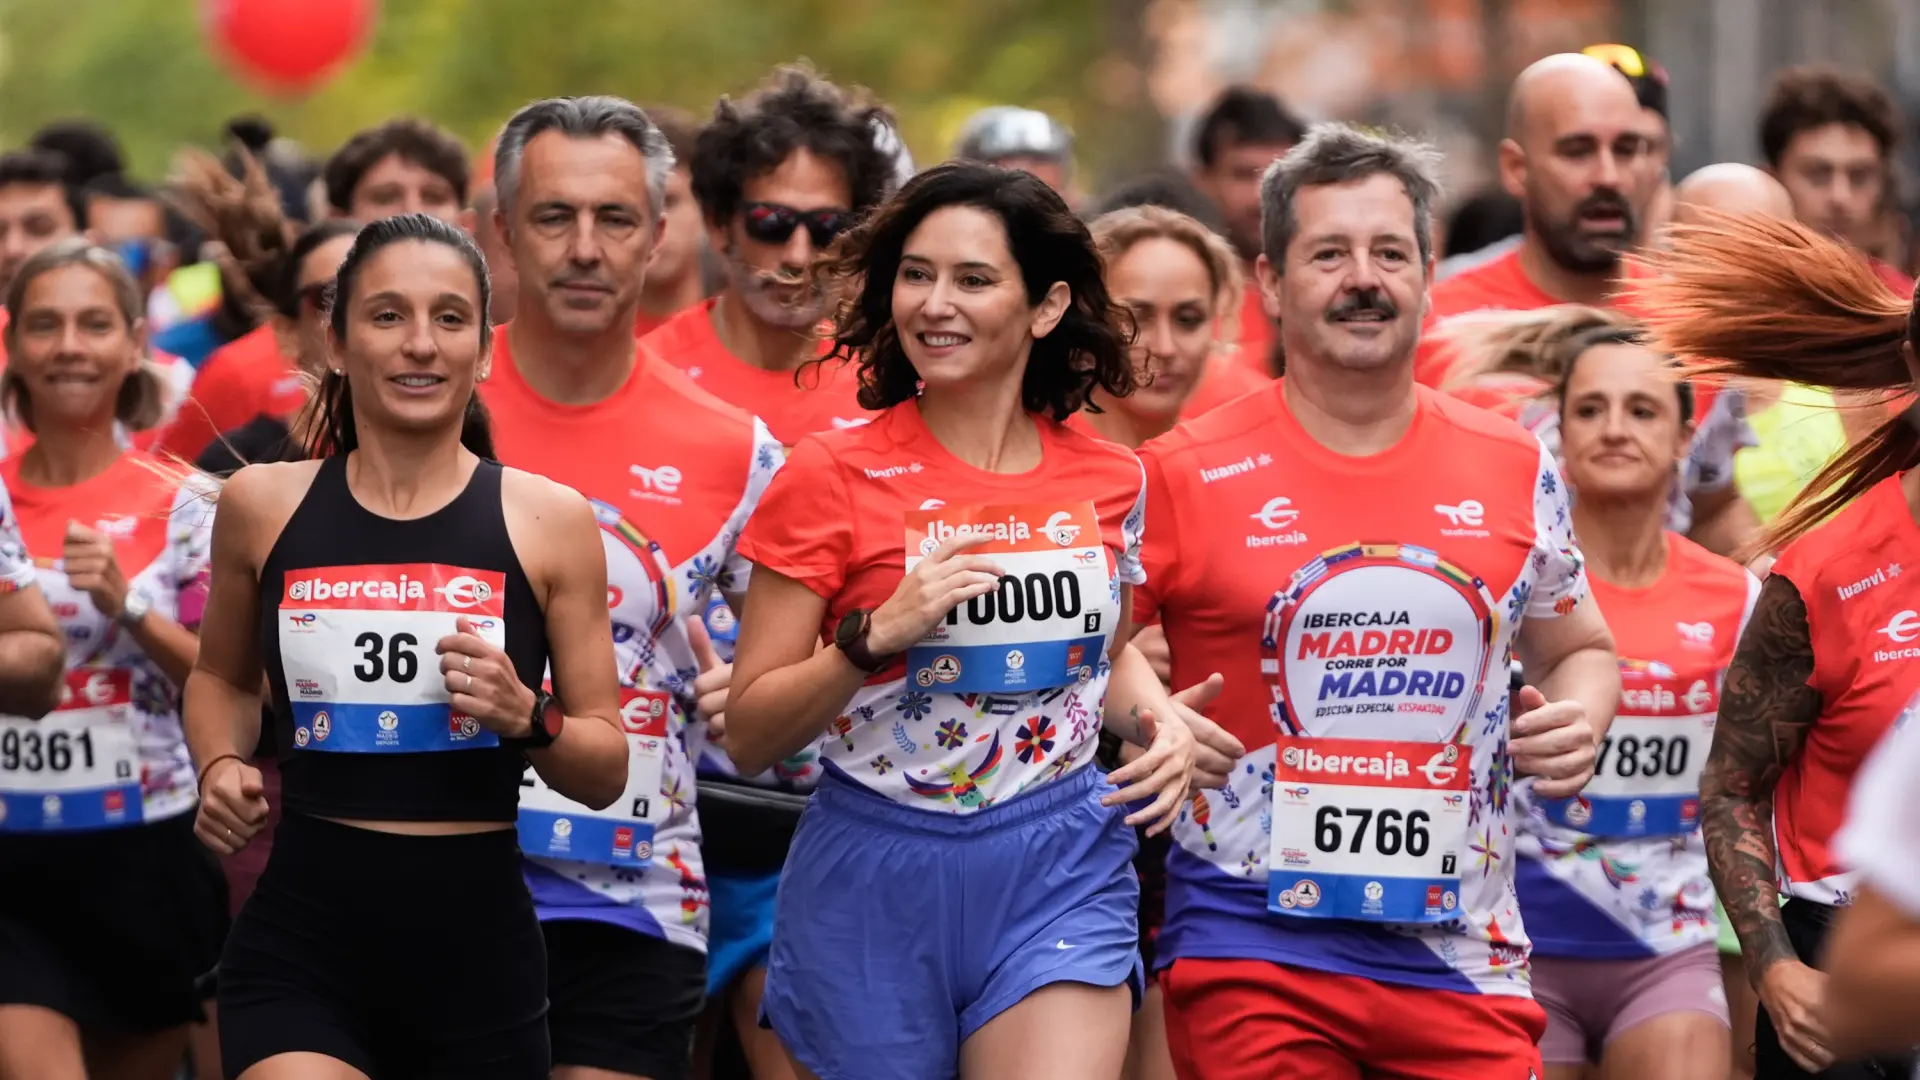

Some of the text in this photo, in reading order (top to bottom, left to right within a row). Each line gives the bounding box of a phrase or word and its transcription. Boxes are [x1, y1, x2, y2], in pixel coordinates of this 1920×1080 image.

[926, 514, 1031, 546] Ibercaja
[1246, 529, 1309, 548] Ibercaja
[303, 573, 427, 604] Ibercaja
[1836, 567, 1887, 602] luanvi
[1303, 610, 1411, 630] IBERCAJA
[353, 631, 418, 684] 36
[1297, 628, 1454, 661] MADRID
[1325, 656, 1408, 671] CORRE POR
[1317, 669, 1466, 702] MADRID
[1622, 684, 1677, 712] caja
[1355, 702, 1395, 715] ESPECIAL
[1, 728, 94, 772] 9361
[1297, 748, 1410, 782] Ibercaja
[1314, 805, 1432, 858] 6766
